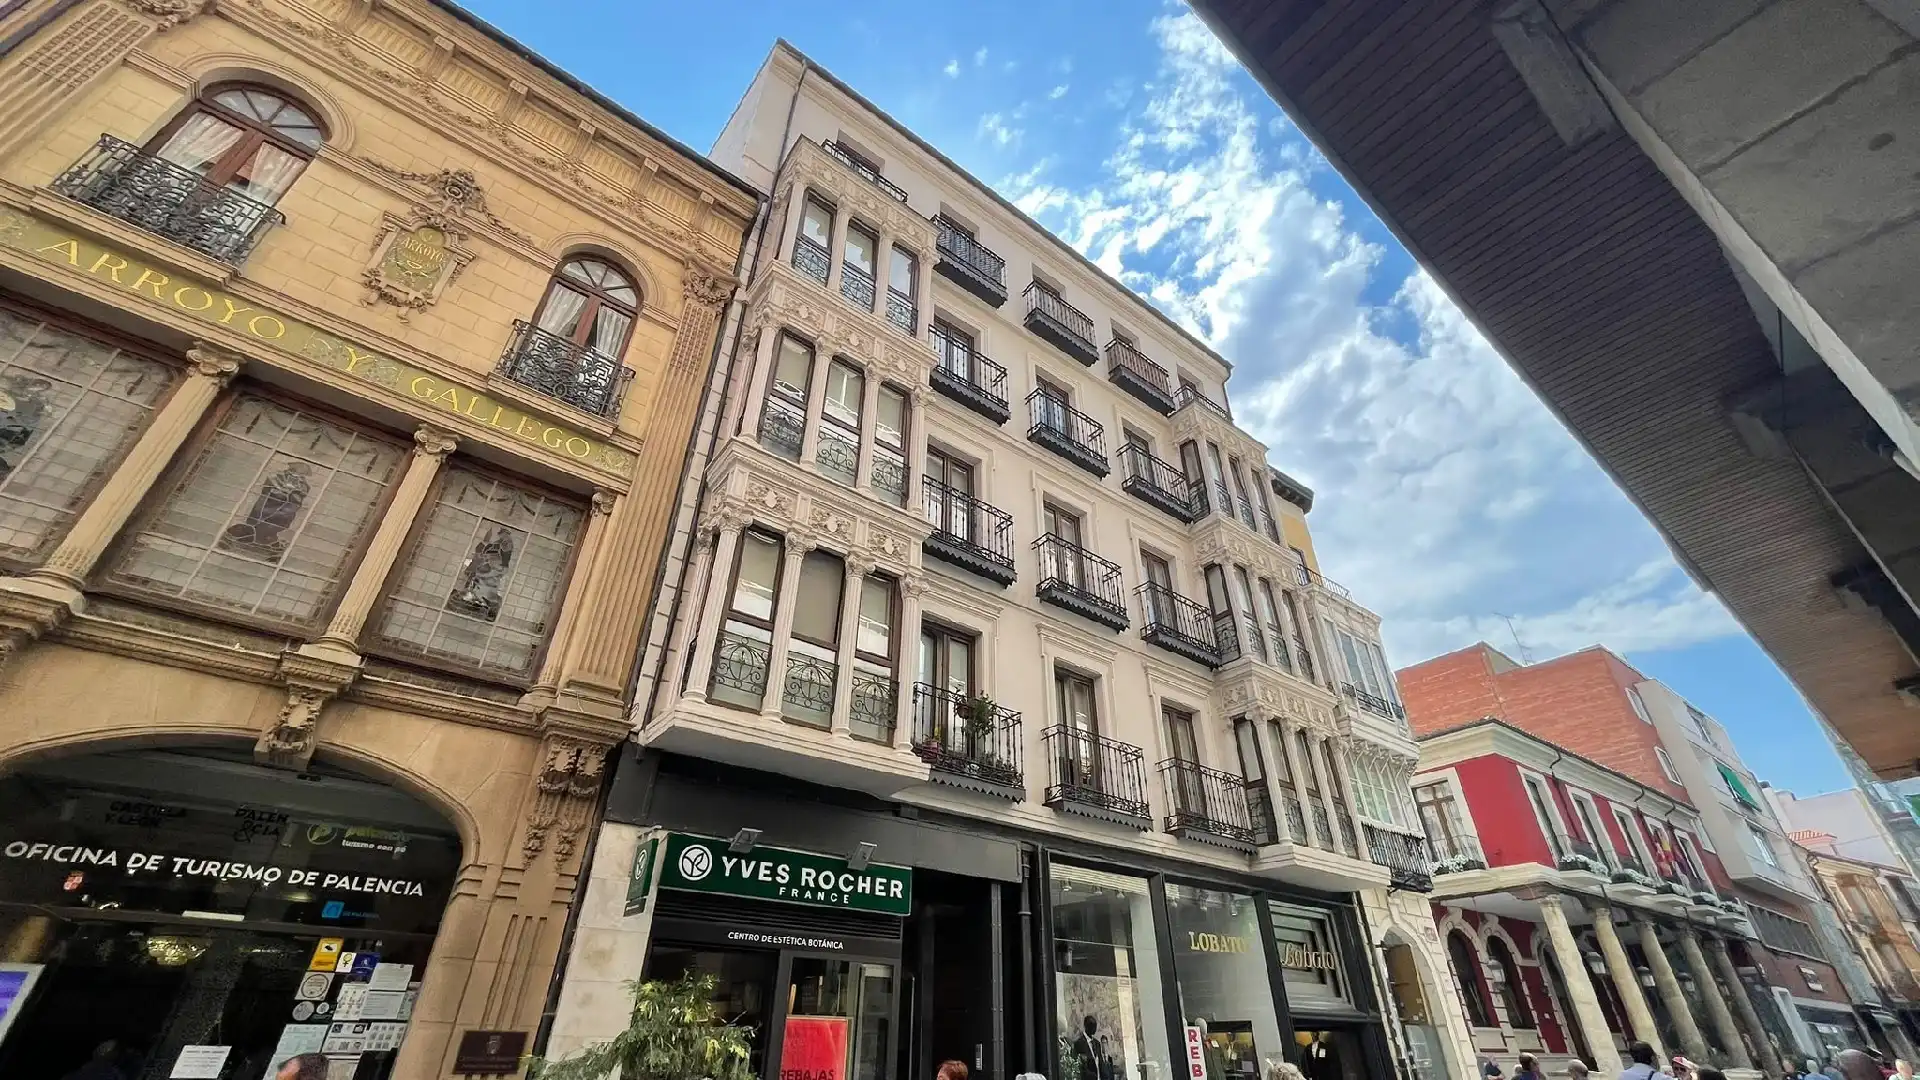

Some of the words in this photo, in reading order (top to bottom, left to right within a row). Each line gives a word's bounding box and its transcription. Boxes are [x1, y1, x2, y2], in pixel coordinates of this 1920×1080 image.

[37, 239, 286, 339] ARROYO
[345, 345, 373, 371] Y
[410, 375, 591, 458] GALLEGO
[4, 841, 118, 866] OFICINA
[126, 852, 165, 871] DE
[172, 857, 282, 882] TURISMO
[288, 869, 320, 886] DE
[322, 873, 424, 897] PALENCIA
[721, 855, 791, 884] YVES
[800, 867, 904, 899] ROCHER
[779, 886, 850, 904] FRANCE
[727, 931, 760, 942] CENTRO
[761, 935, 773, 943] DE
[773, 936, 807, 946] ESTÉTICA
[808, 938, 844, 950] BOTÁNICA
[1188, 931, 1249, 953] LOBATO
